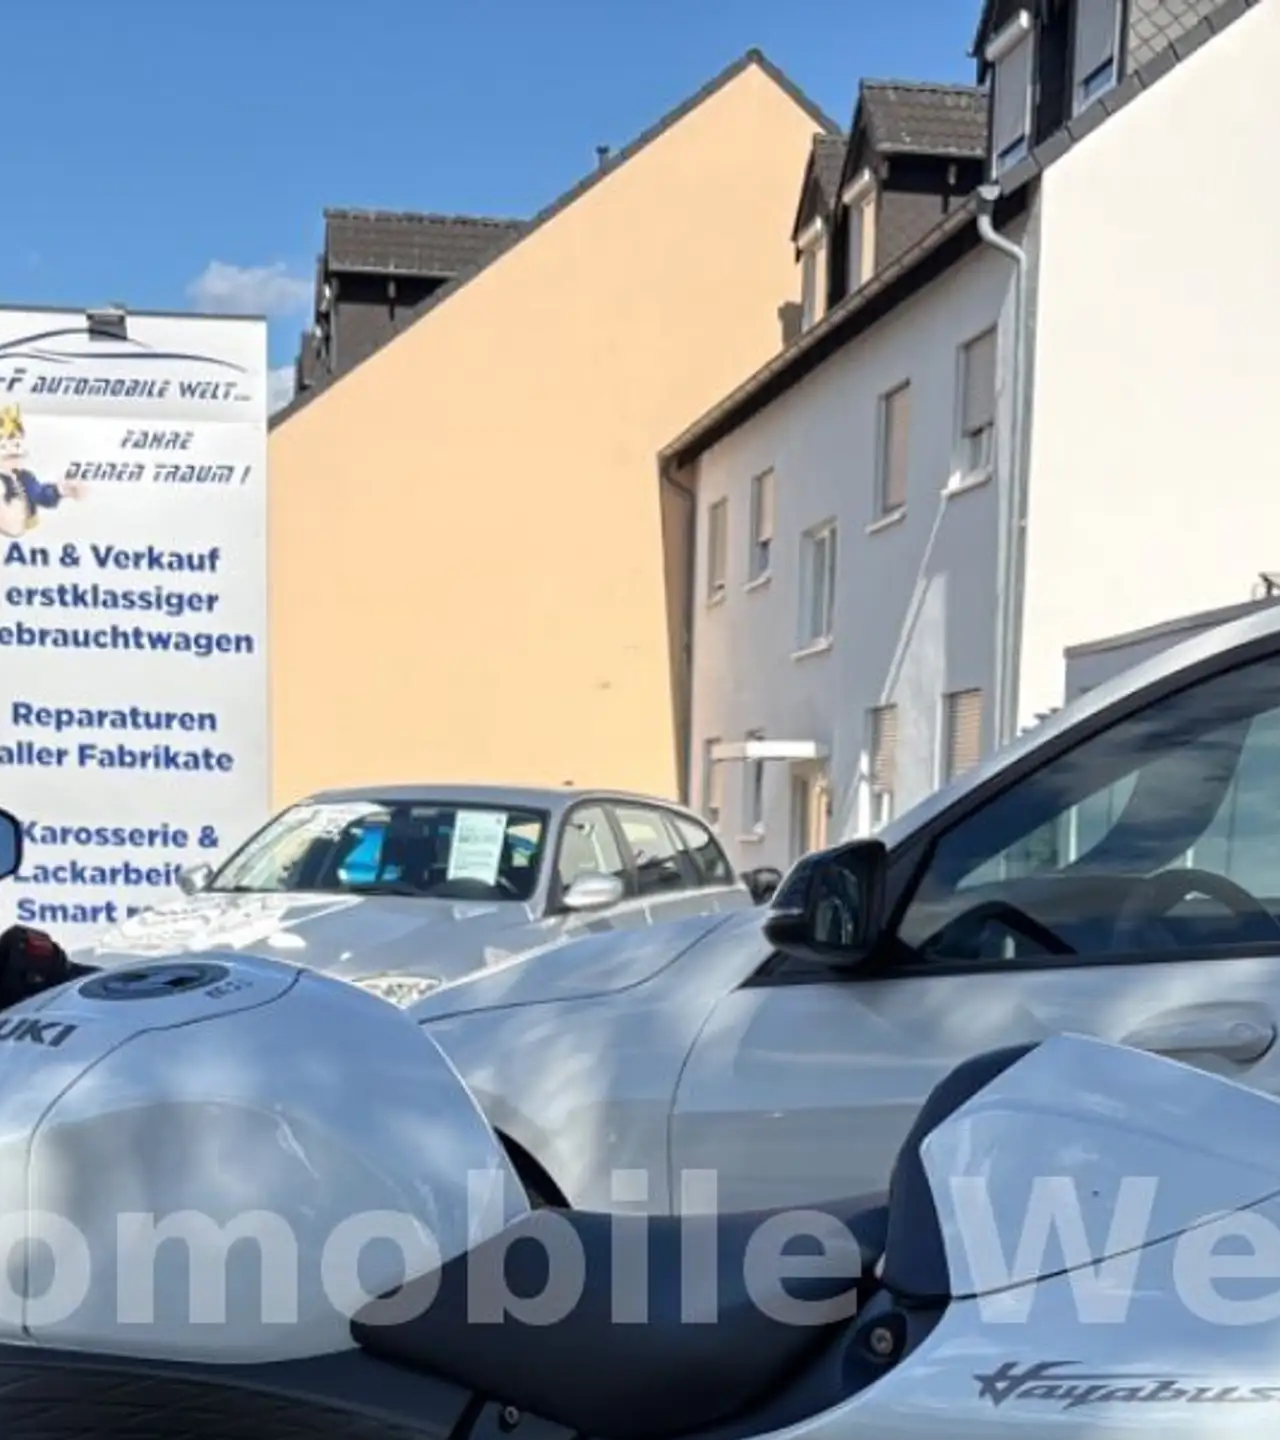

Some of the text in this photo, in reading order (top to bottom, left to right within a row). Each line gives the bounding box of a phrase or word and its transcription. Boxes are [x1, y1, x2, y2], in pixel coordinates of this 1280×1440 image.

[31, 376, 172, 399] AUTOMOBILE
[120, 429, 195, 451] FAHRE
[152, 463, 236, 485] TRAUM
[3, 541, 221, 573] An & Verkauf
[4, 583, 220, 617] erstklassiger
[10, 701, 218, 732] Reparaturen
[77, 743, 236, 773] Fabrikate
[21, 822, 220, 849] Karosserie &
[16, 897, 118, 924] Smart
